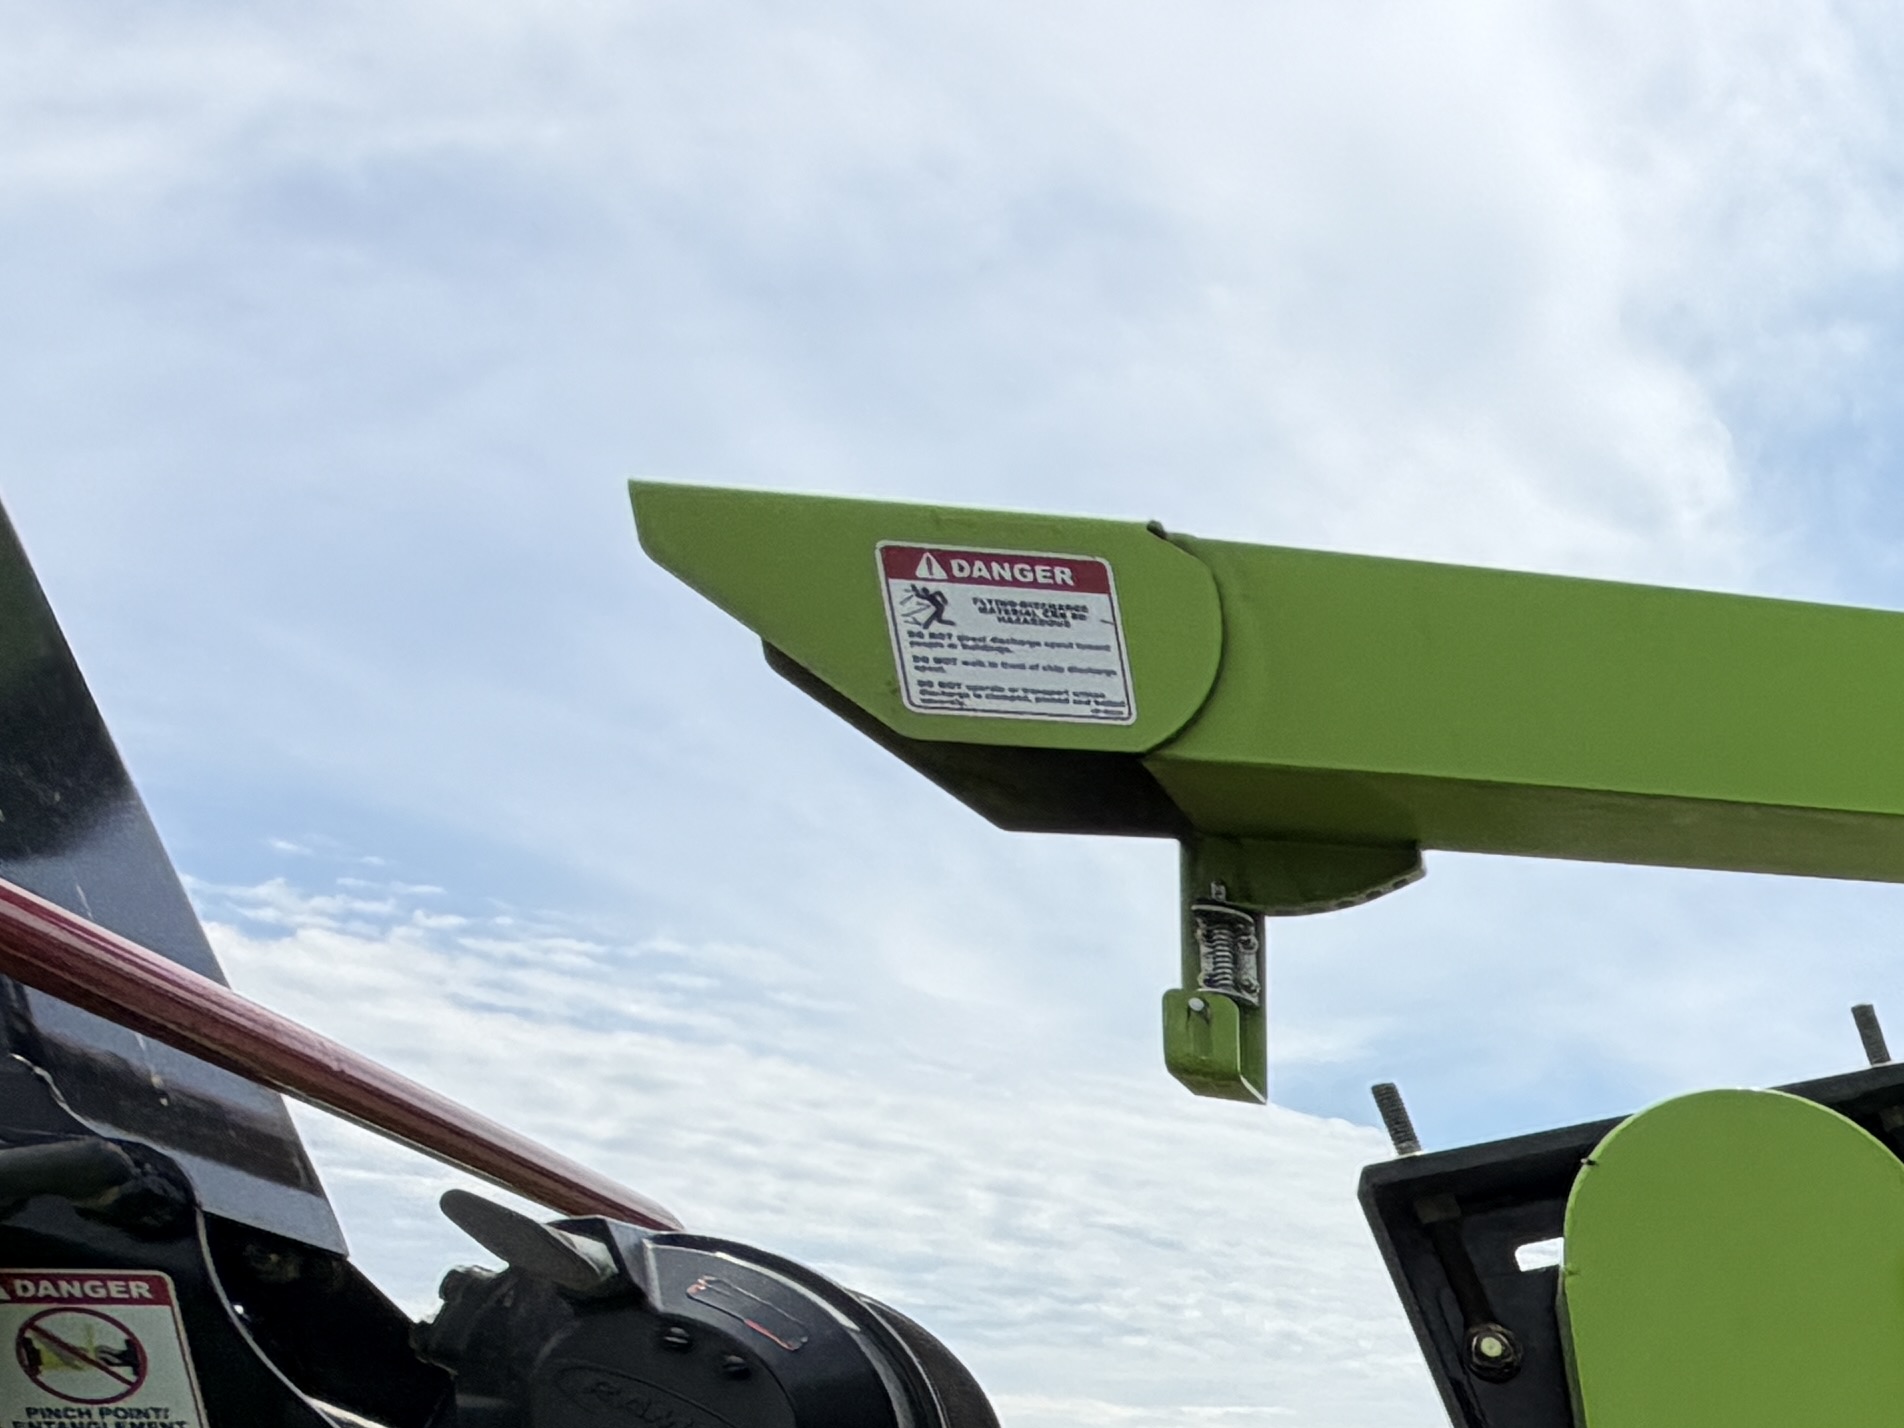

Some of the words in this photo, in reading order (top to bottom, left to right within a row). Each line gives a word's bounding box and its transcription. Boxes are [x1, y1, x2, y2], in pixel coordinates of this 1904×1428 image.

[949, 558, 1074, 586] DANGER
[13, 1279, 153, 1299] DANGER
[25, 1406, 92, 1420] PINCH
